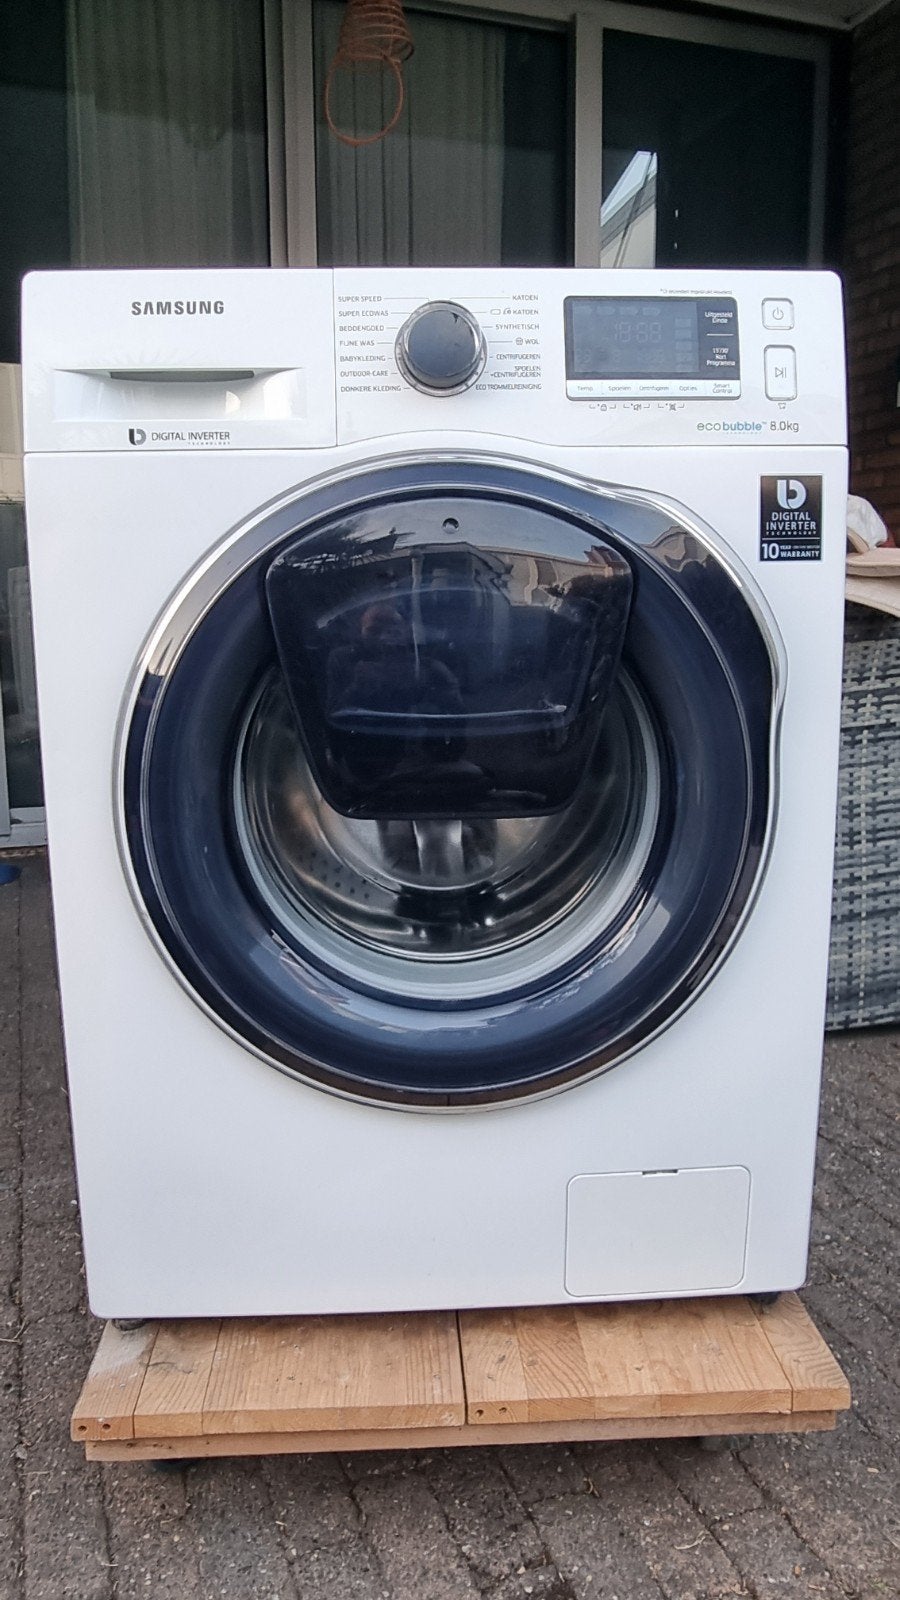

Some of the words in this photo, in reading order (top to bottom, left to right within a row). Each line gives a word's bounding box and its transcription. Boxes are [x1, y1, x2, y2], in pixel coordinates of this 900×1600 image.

[337, 295, 360, 303] SUPER
[131, 300, 225, 316] SAMSUNG
[340, 385, 372, 393] DONKERE
[769, 421, 800, 433] 8.0kg
[151, 431, 186, 441] DIGITAL
[187, 431, 231, 441] INVERTER
[771, 511, 811, 521] DIGITAL
[766, 521, 817, 531] INVERTER
[761, 543, 780, 560] 10
[780, 550, 820, 558] WARRANTY
